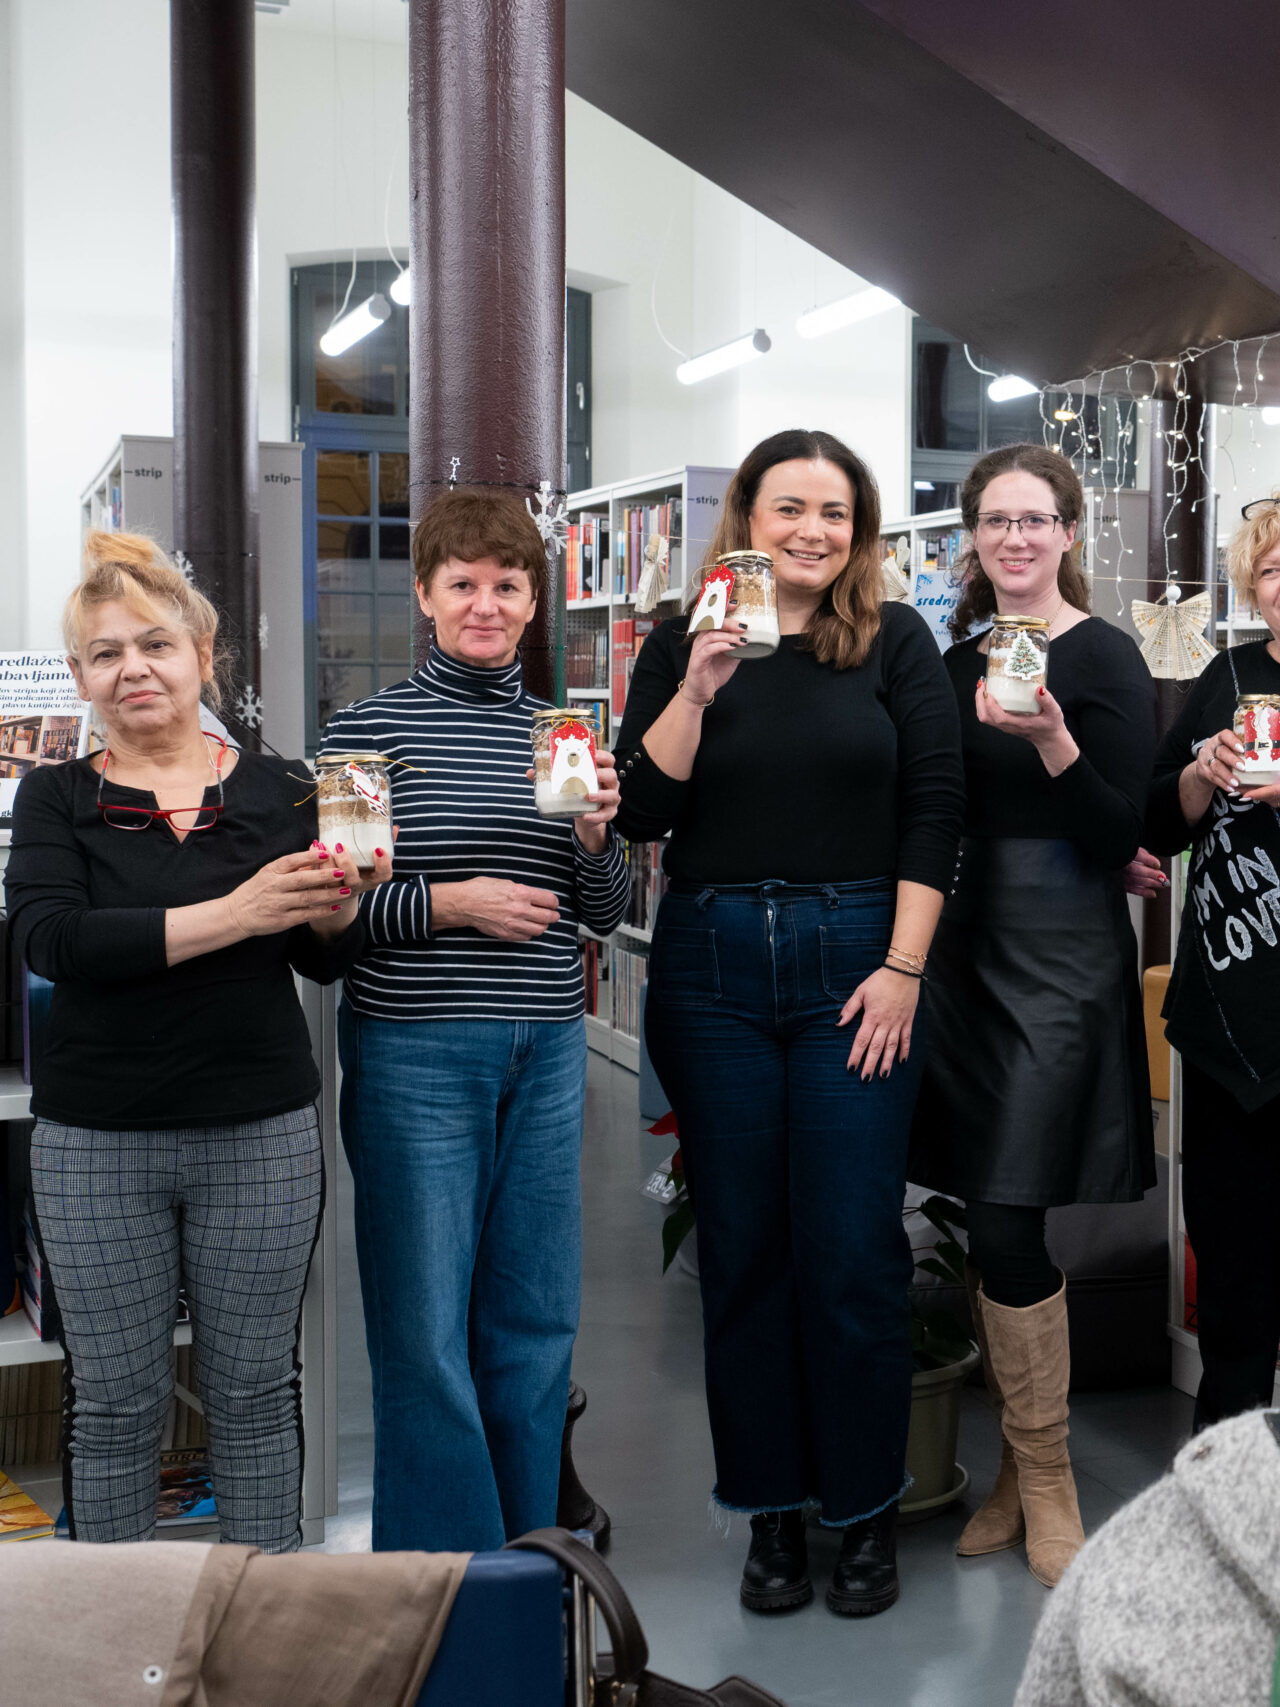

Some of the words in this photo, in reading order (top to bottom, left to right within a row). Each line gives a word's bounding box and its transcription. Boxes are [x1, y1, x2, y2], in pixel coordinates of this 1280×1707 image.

[134, 468, 162, 479] strip
[264, 473, 292, 485] strip
[695, 496, 719, 507] strip
[40, 687, 57, 695] koji
[1227, 846, 1280, 893] IN
